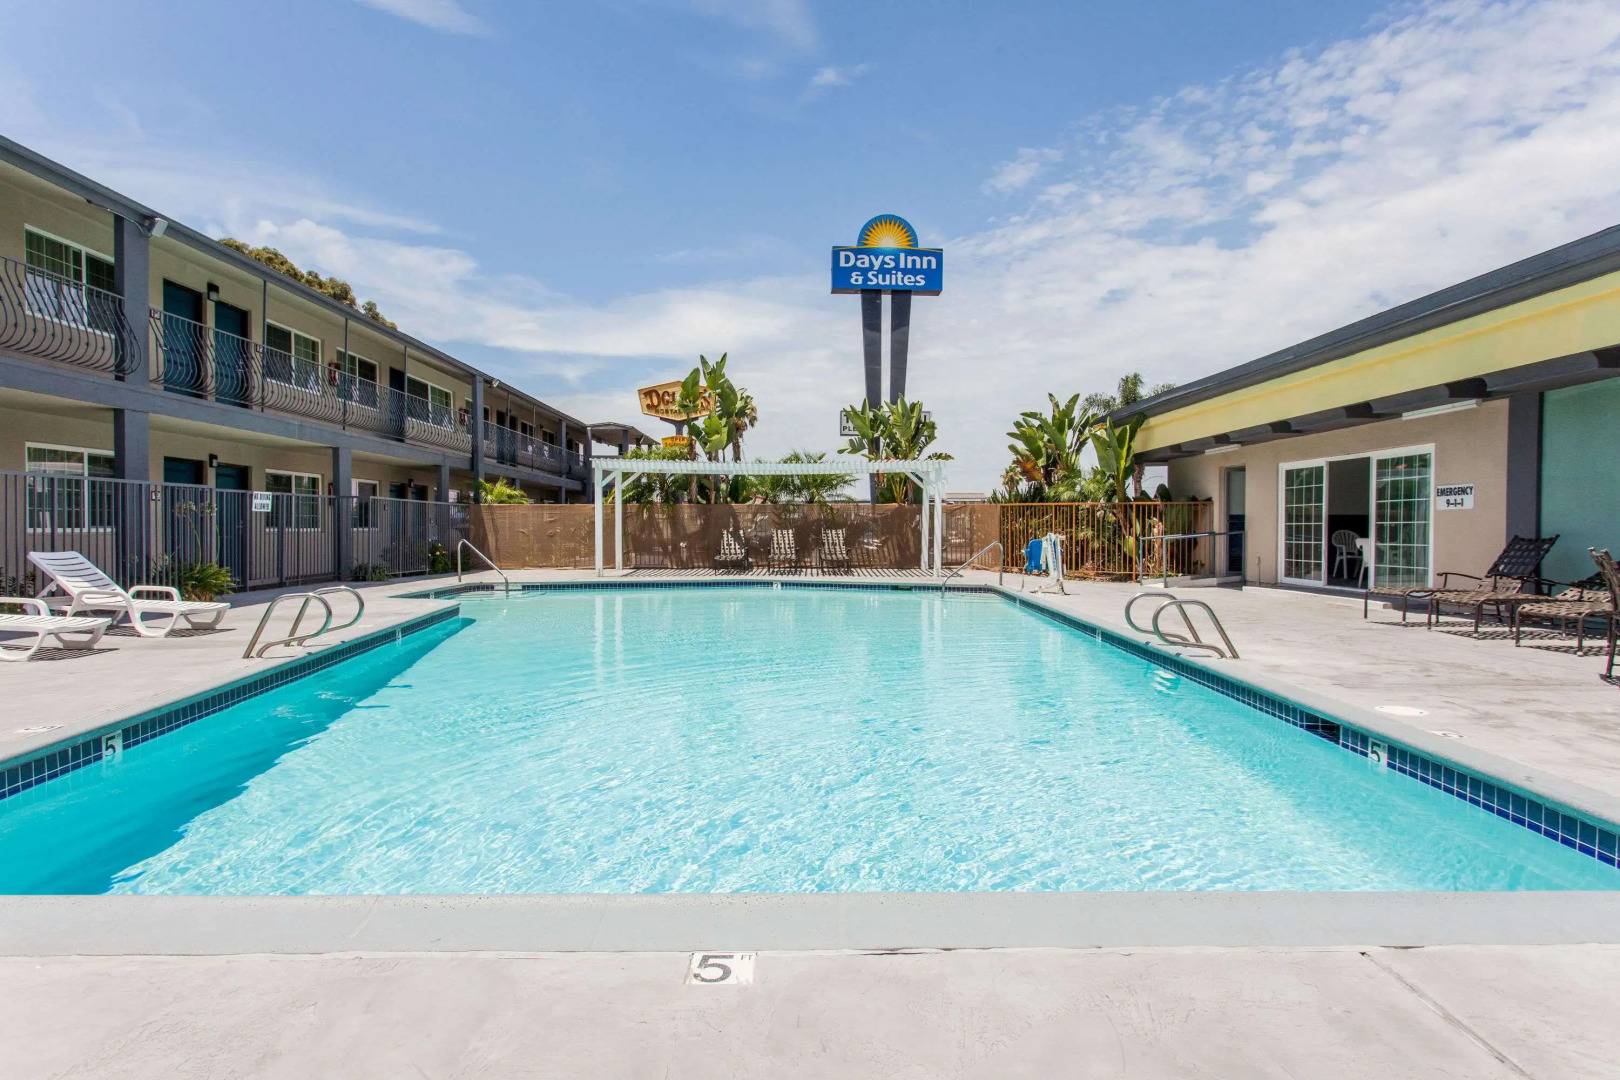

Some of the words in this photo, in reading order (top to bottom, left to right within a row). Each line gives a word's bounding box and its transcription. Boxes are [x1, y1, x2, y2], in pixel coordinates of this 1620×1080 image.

[839, 251, 896, 270] Days
[899, 252, 937, 269] Inn
[850, 271, 864, 285] &
[867, 270, 926, 286] Suites
[1436, 486, 1474, 497] EMERGENCY
[1445, 498, 1464, 507] 9-1-1
[105, 734, 117, 757] 5
[1370, 740, 1381, 763] 5
[693, 954, 734, 983] 5
